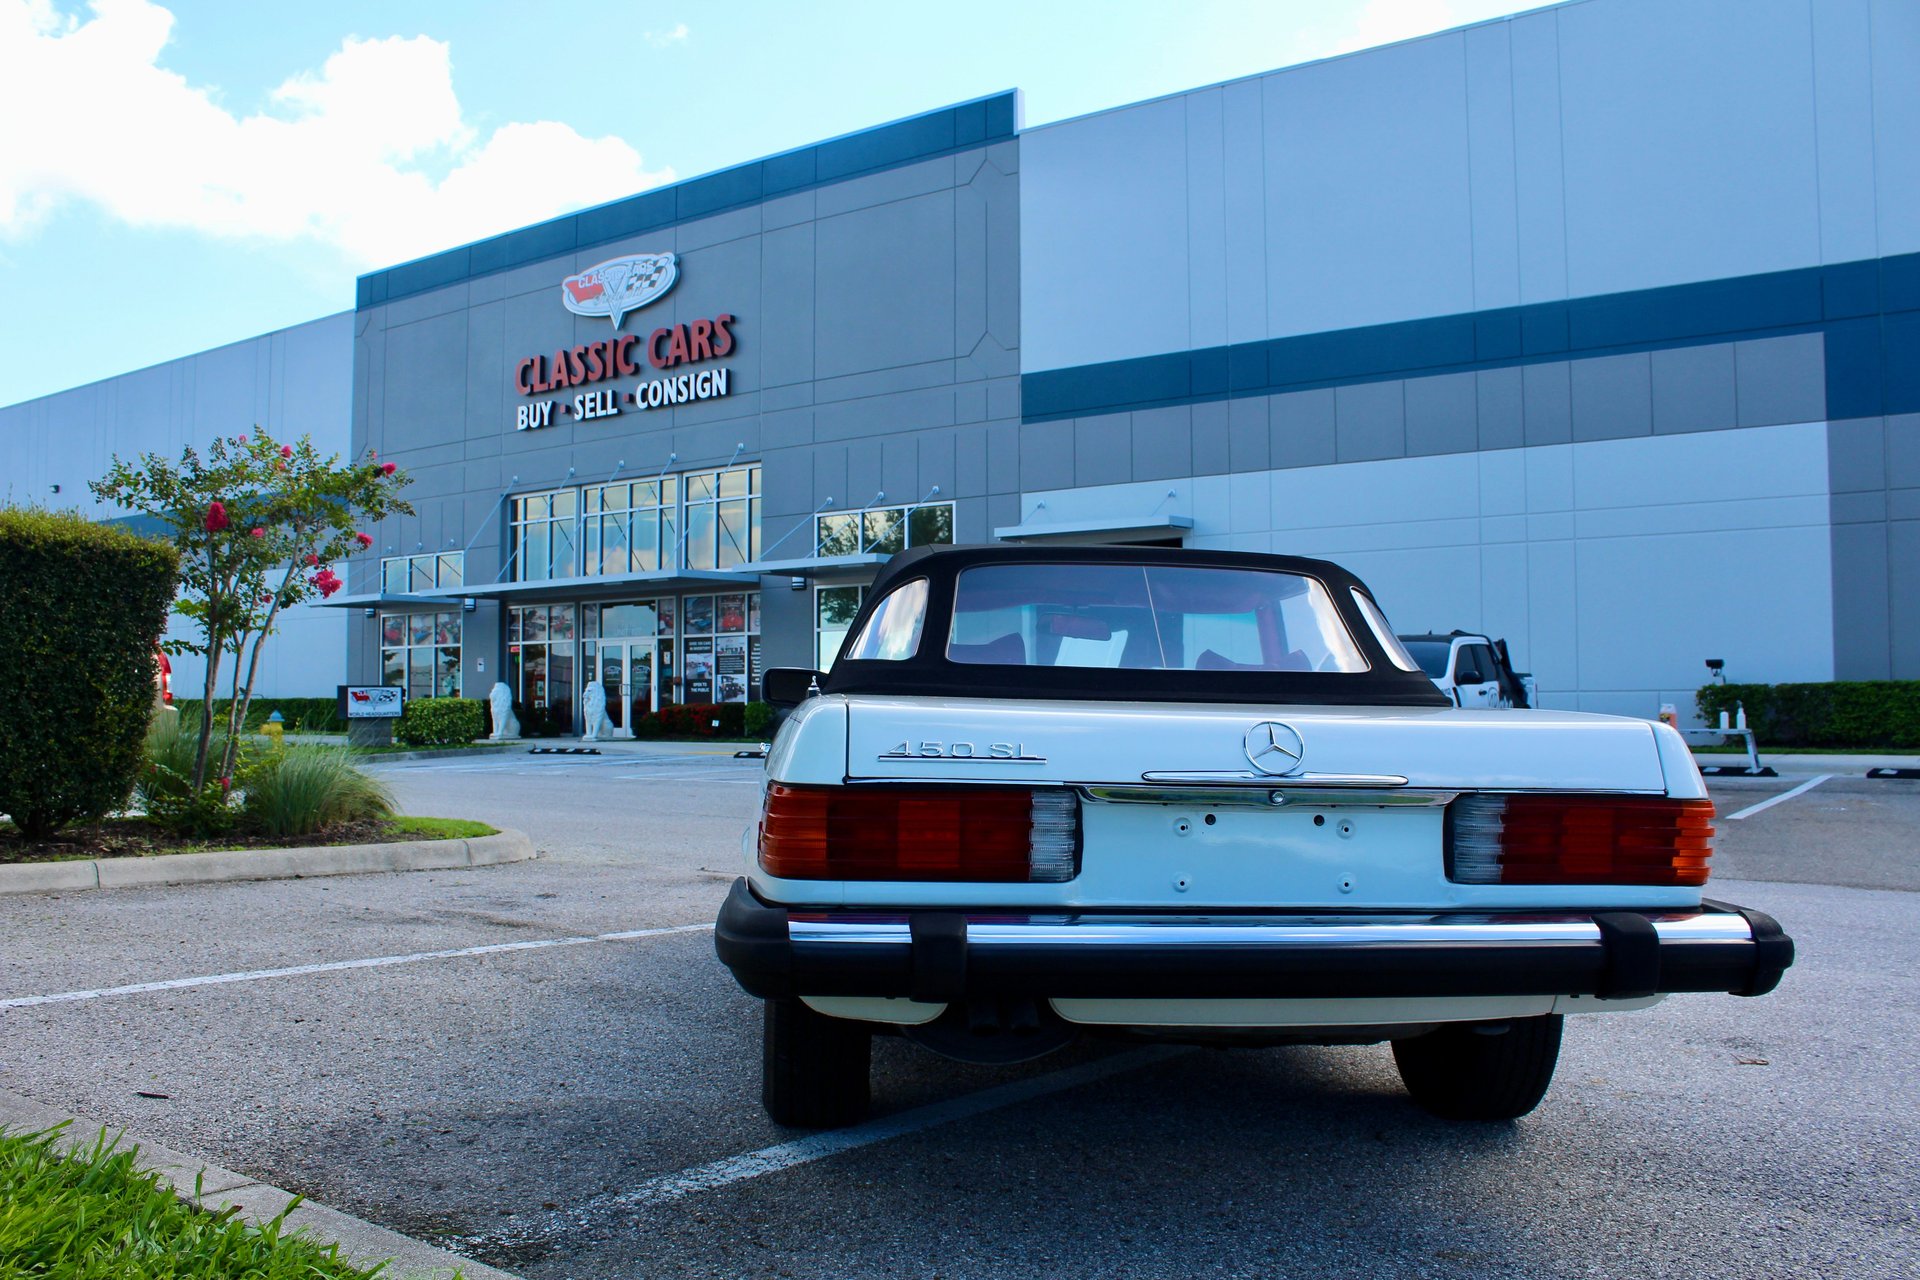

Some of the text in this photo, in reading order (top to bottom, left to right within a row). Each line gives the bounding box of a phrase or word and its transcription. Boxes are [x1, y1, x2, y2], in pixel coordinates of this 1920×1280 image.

[514, 313, 735, 396] CLASSIC CARS
[517, 367, 729, 431] BUY SELL CONSIGN
[887, 740, 1039, 759] 450 SL
